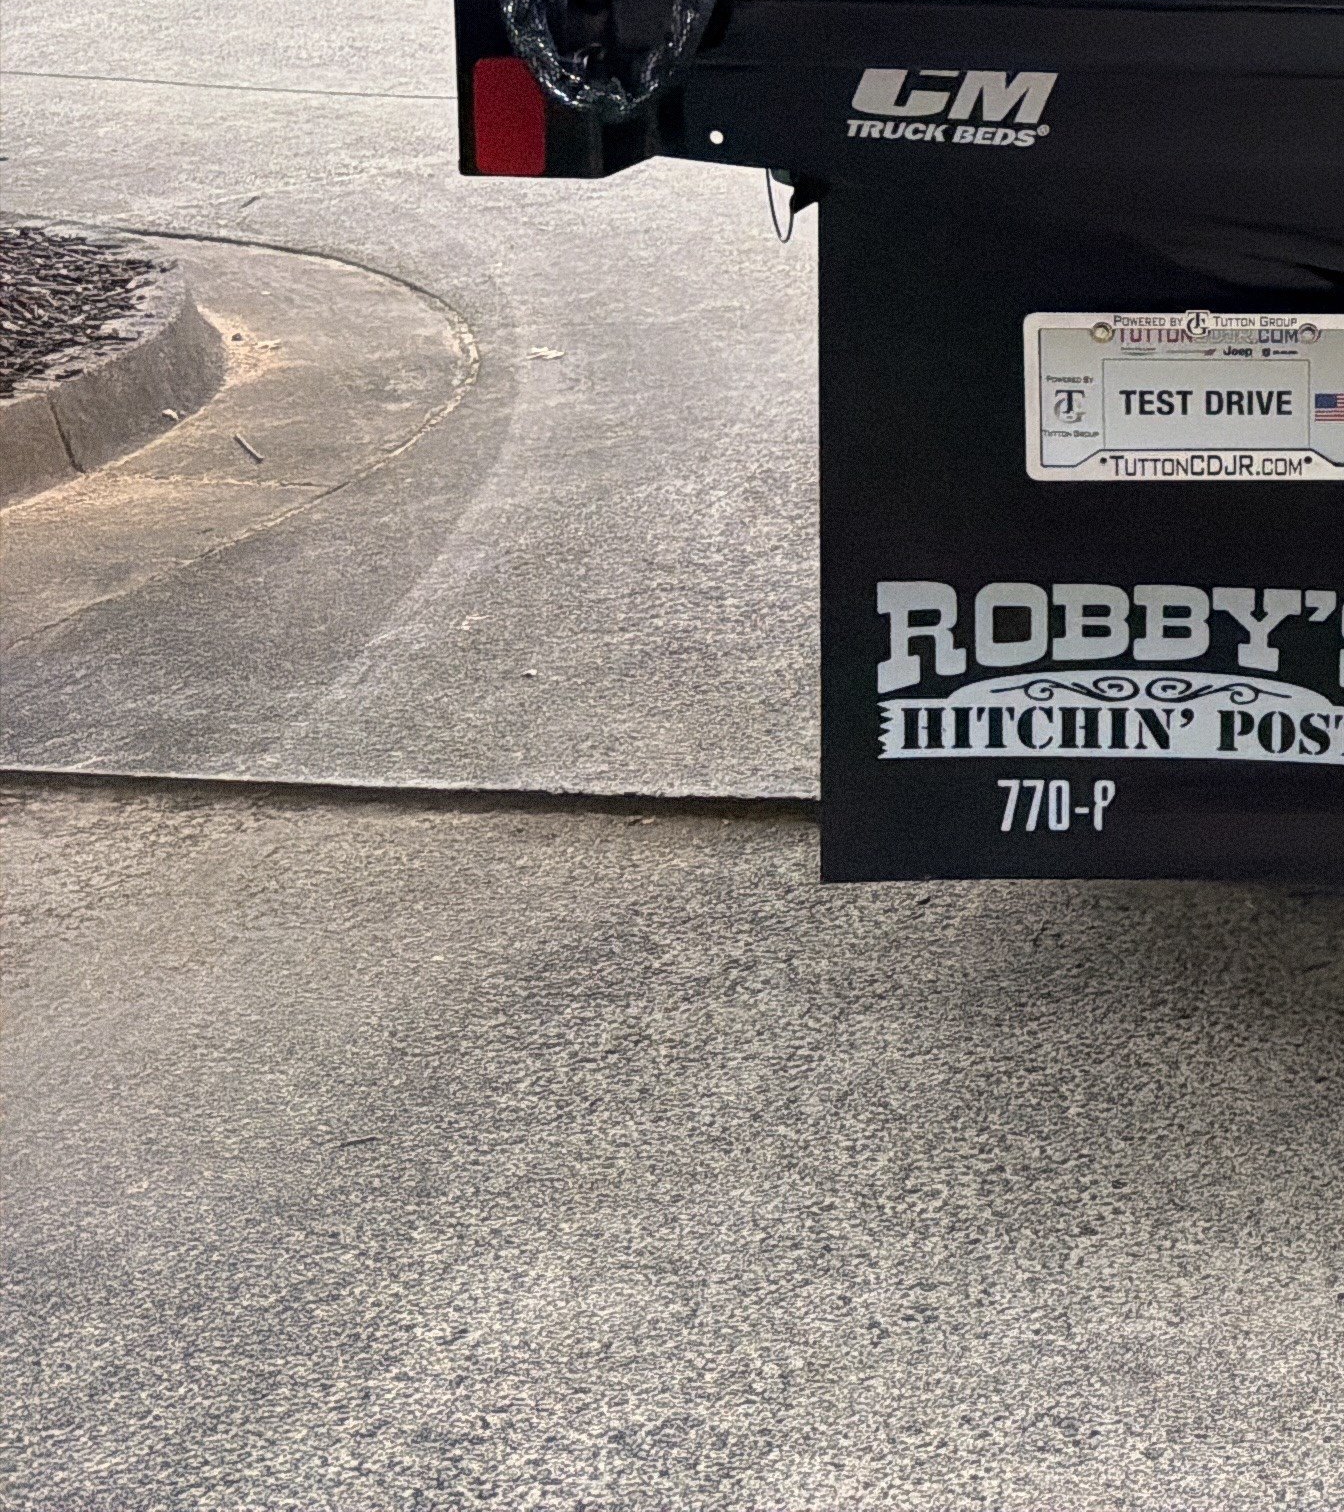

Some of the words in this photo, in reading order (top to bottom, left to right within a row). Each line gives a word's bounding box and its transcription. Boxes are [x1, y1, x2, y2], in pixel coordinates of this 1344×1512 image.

[847, 119, 949, 143] TRUCK
[1223, 346, 1253, 357] Jeep
[1119, 390, 1193, 416] TEST
[1205, 390, 1292, 416] DRIVE
[901, 706, 1196, 752] HITCHIN'
